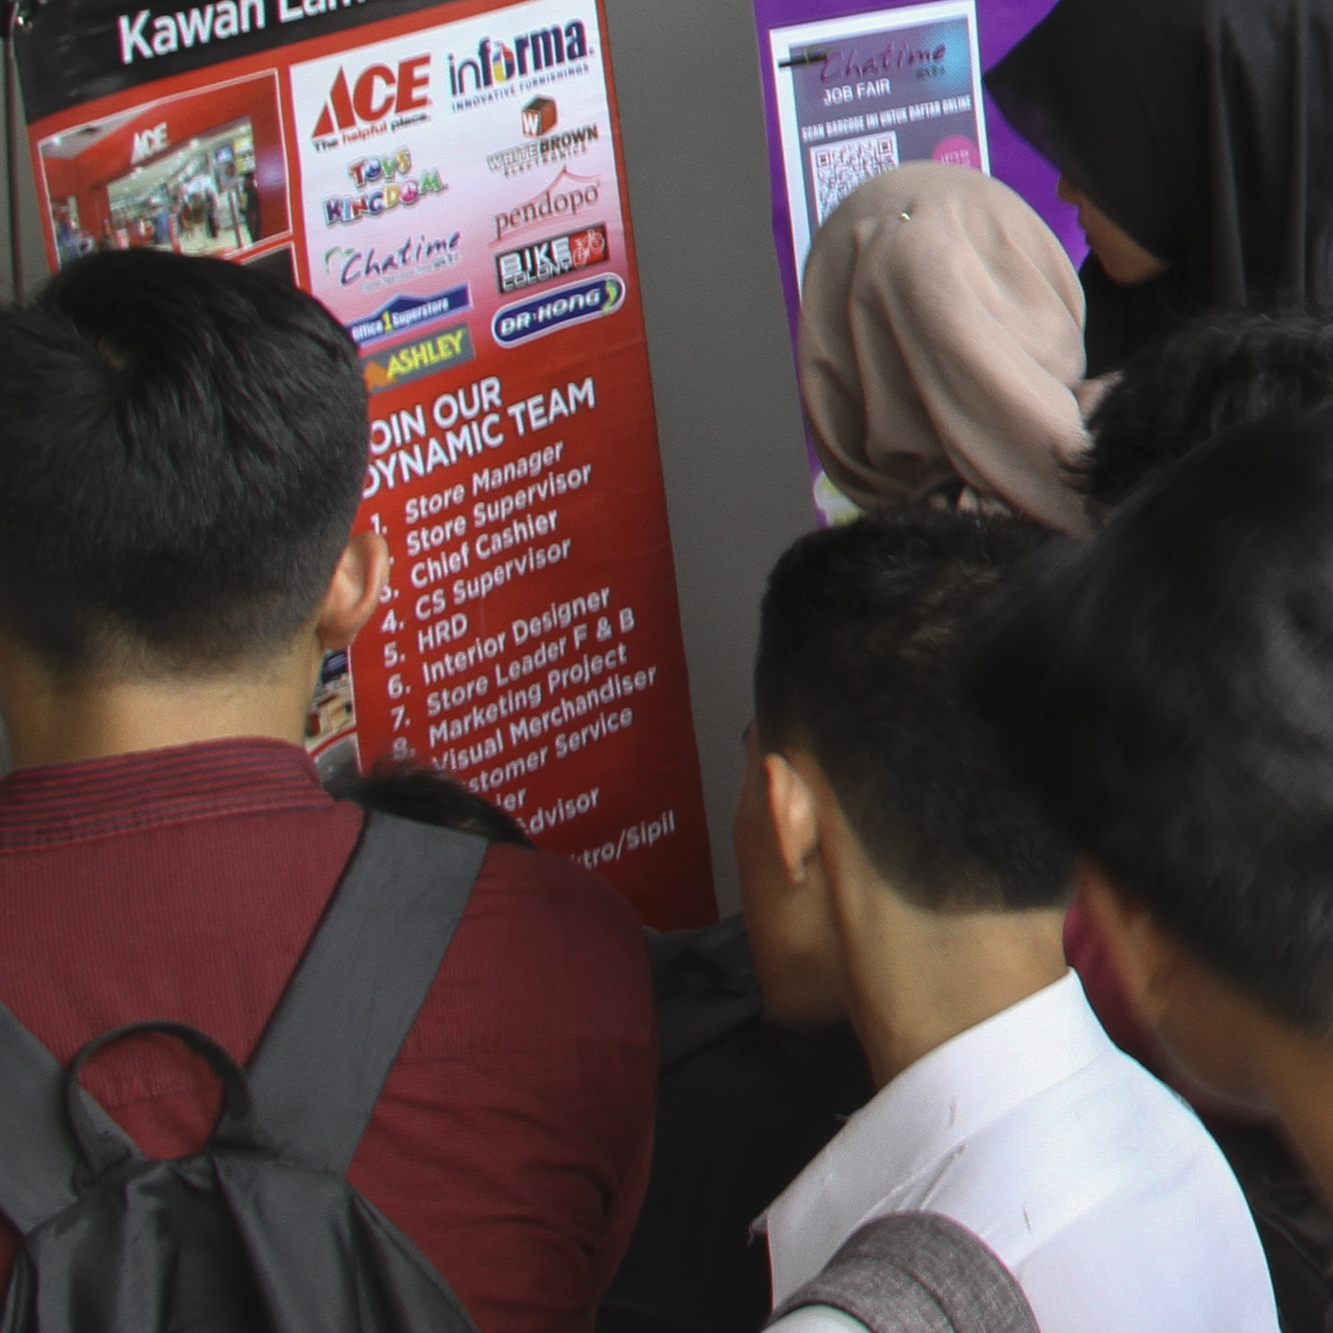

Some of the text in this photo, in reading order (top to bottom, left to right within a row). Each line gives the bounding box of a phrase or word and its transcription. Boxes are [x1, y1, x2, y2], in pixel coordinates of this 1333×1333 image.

[448, 18, 589, 96] informa
[820, 41, 947, 83] Chatime
[311, 52, 432, 138] ACE
[801, 123, 826, 144] SCAN
[866, 112, 880, 130] INI
[880, 106, 908, 127] UNTUK
[908, 100, 942, 122] DAFTAR
[942, 94, 972, 116] ONLINE
[823, 78, 892, 107] JOB FAIR
[130, 121, 170, 165] ACE
[342, 120, 389, 145] helpful
[348, 145, 413, 188] TOYS
[322, 168, 443, 225] KINGDOM
[494, 184, 599, 240] pendopo
[340, 231, 461, 285] Chatime
[500, 235, 572, 277] BIKE
[352, 297, 449, 342] Office 1 Superstore
[386, 327, 467, 381] ASHLEY
[369, 375, 503, 455] OIN OUR
[507, 376, 596, 437] TEAM
[405, 482, 466, 525] Store
[471, 440, 564, 497] Manager
[406, 463, 593, 557] Store Supervisor
[410, 541, 470, 589] Chief
[475, 508, 558, 561] Cashier
[381, 537, 572, 634] 4. CS Supervisor
[383, 612, 469, 668] 5. HRD
[387, 586, 611, 700] 6. Interior Designer
[390, 606, 636, 732] 7. Store Leader F & B
[428, 681, 543, 750] Marketing
[547, 641, 628, 695] Project
[509, 665, 658, 747] Merchandiser
[463, 707, 634, 795] stomer Service
